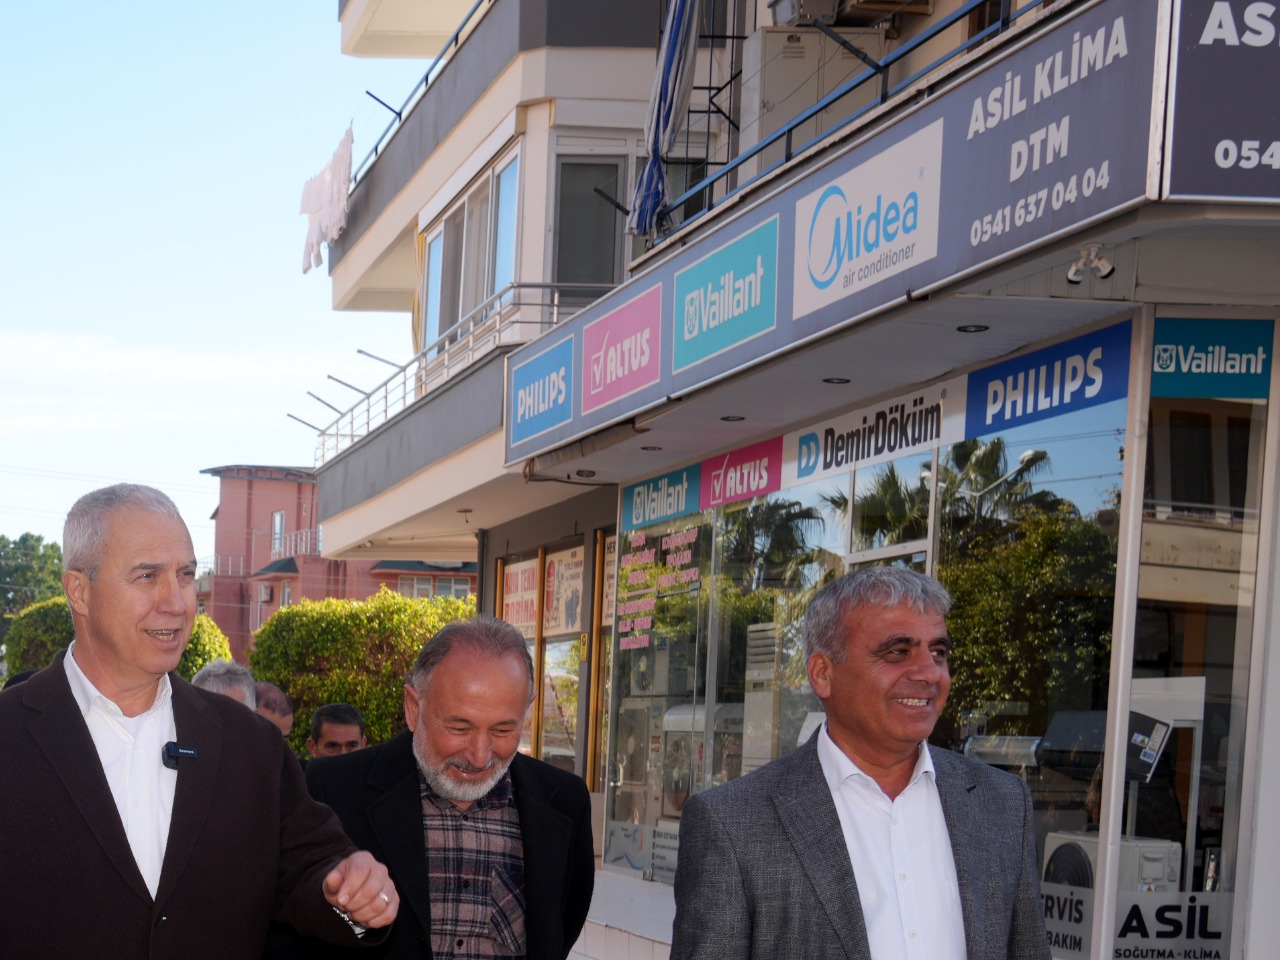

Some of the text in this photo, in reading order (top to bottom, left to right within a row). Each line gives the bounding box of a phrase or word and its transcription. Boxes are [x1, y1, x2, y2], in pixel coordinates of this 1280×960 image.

[1198, 1, 1280, 47] AS
[967, 16, 1128, 141] ASİL KLİMA
[1009, 115, 1070, 183] DTM
[970, 160, 1109, 247] 0541 637 04 04
[808, 185, 918, 289] Midea
[843, 242, 916, 288] air conditioner
[698, 255, 764, 333] Vaillant
[606, 327, 650, 384] ALTUS
[1178, 345, 1266, 374] Vaillant
[517, 366, 566, 423] PHILIPS
[985, 347, 1103, 426] PHILIPS
[823, 396, 942, 471] DemirDöküm
[642, 470, 688, 523] Vaillant
[726, 456, 768, 498] ALTUS
[1041, 891, 1084, 924] RVİS
[1117, 895, 1222, 939] ASİL
[1114, 945, 1175, 960] SOĞUTMA
[1183, 946, 1222, 960] KLİMA
